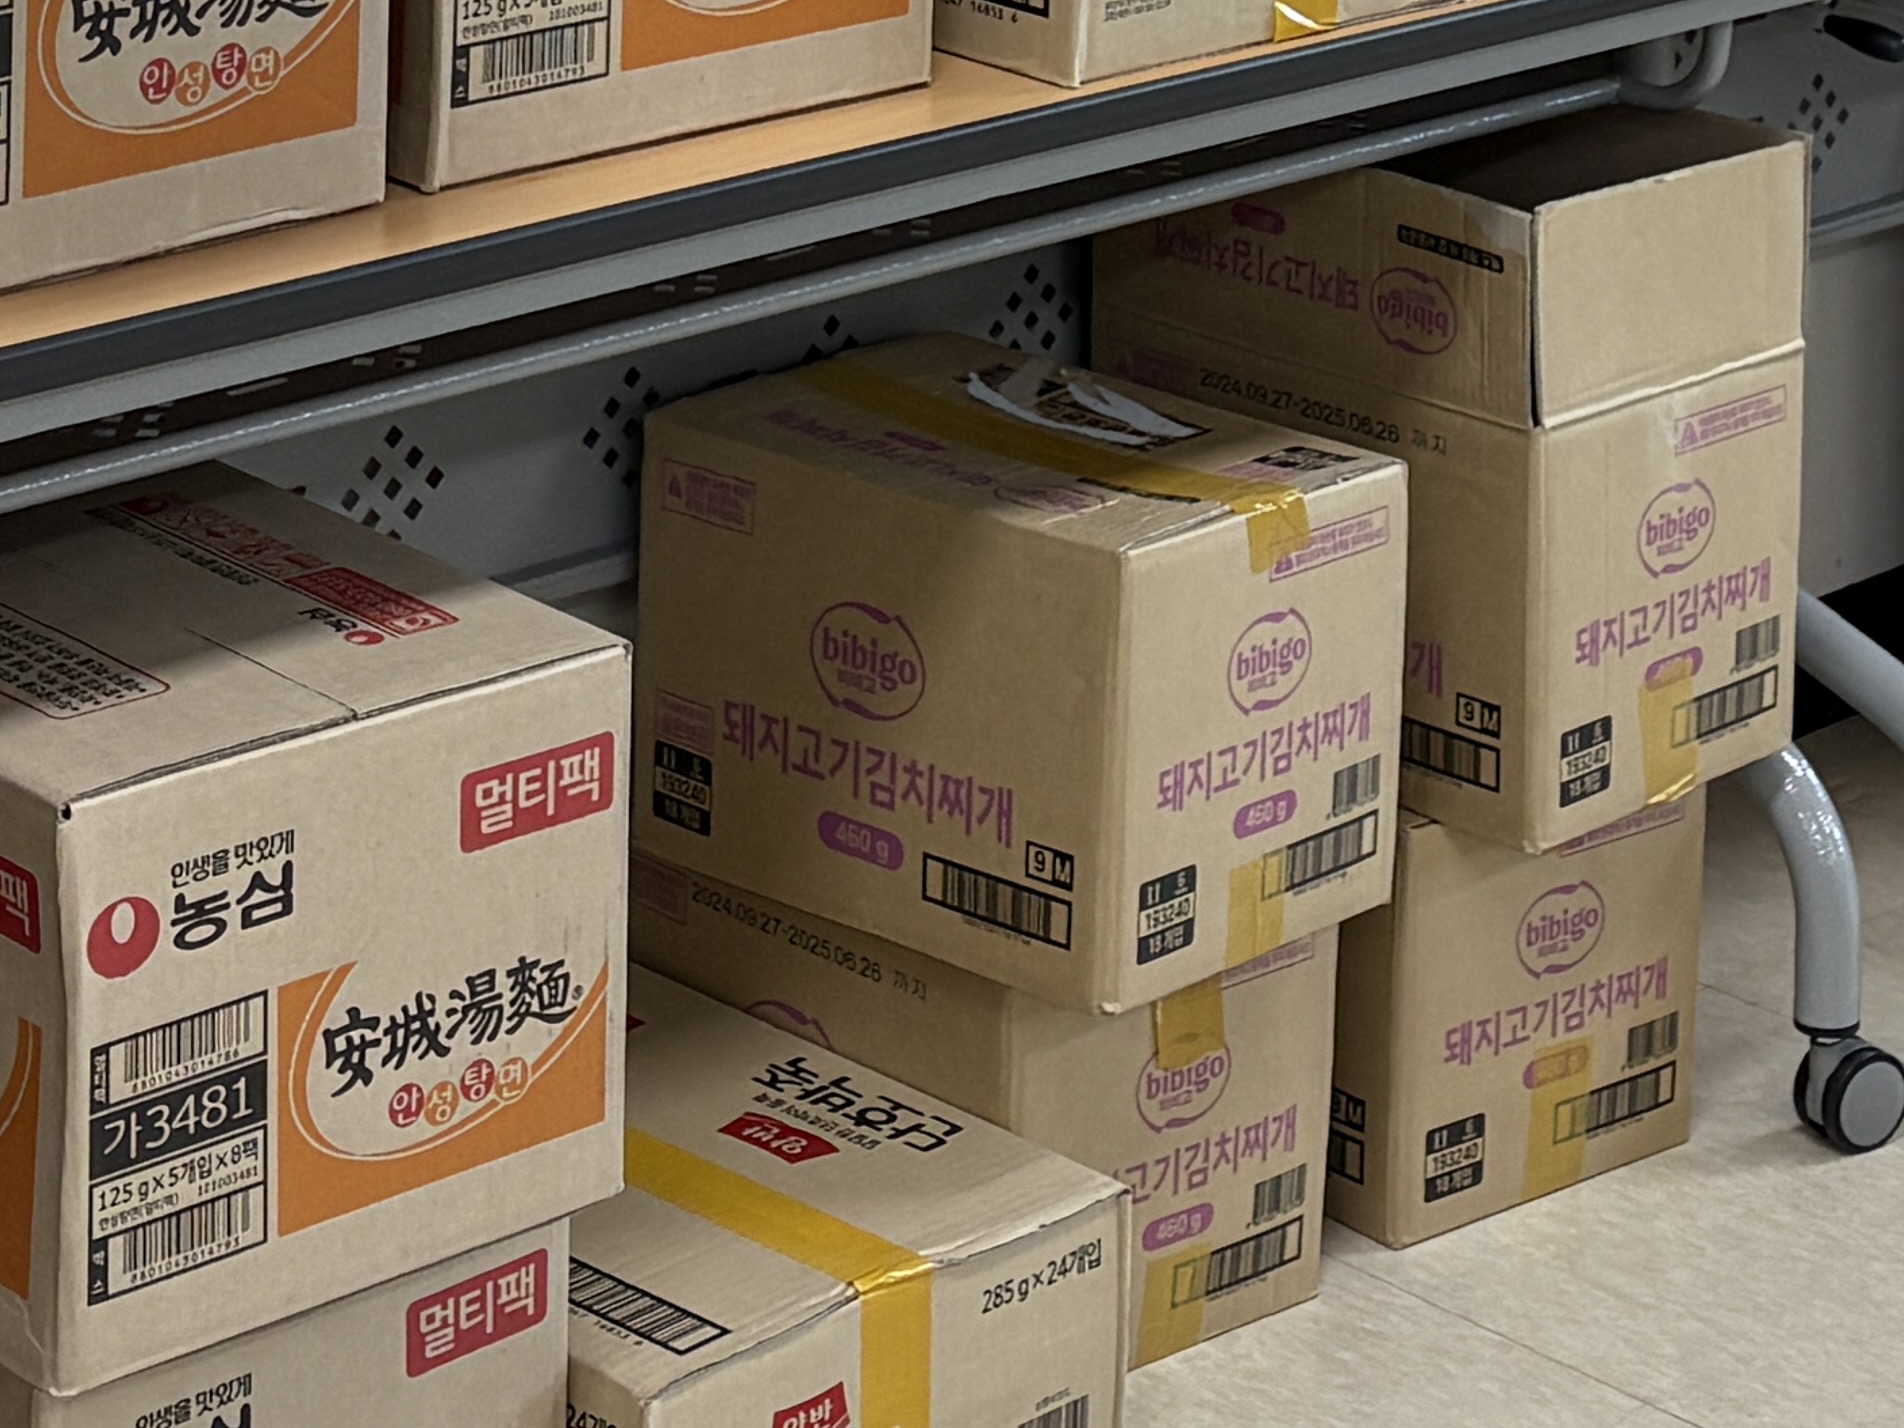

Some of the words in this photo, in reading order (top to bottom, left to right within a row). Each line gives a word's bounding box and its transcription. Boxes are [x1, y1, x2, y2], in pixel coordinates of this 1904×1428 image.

[140, 43, 279, 104] 안성탕면
[1645, 505, 1711, 549] bibigo
[1575, 556, 1772, 667] 돼지고기김치찌개
[819, 629, 919, 688] bibigo
[1235, 636, 1308, 685] bibigo
[1462, 699, 1478, 726] 9
[722, 699, 1015, 849] 돼지고기김치찌개
[1156, 693, 1373, 814] 돼지고기김치찌개
[474, 745, 601, 835] 멀티팩
[170, 848, 231, 889] 인생을
[233, 828, 295, 871] 맛있게
[1032, 848, 1047, 875] 9
[1055, 856, 1073, 884] M
[169, 859, 294, 951] 농심
[1525, 905, 1600, 949] bibigo
[1443, 954, 1669, 1067] 돼지고기김치찌개
[103, 1075, 255, 1160] 가3481
[389, 1055, 530, 1127] 안성탕면
[417, 1265, 536, 1357] 멀티팩
[195, 1372, 253, 1419] 맛있게
